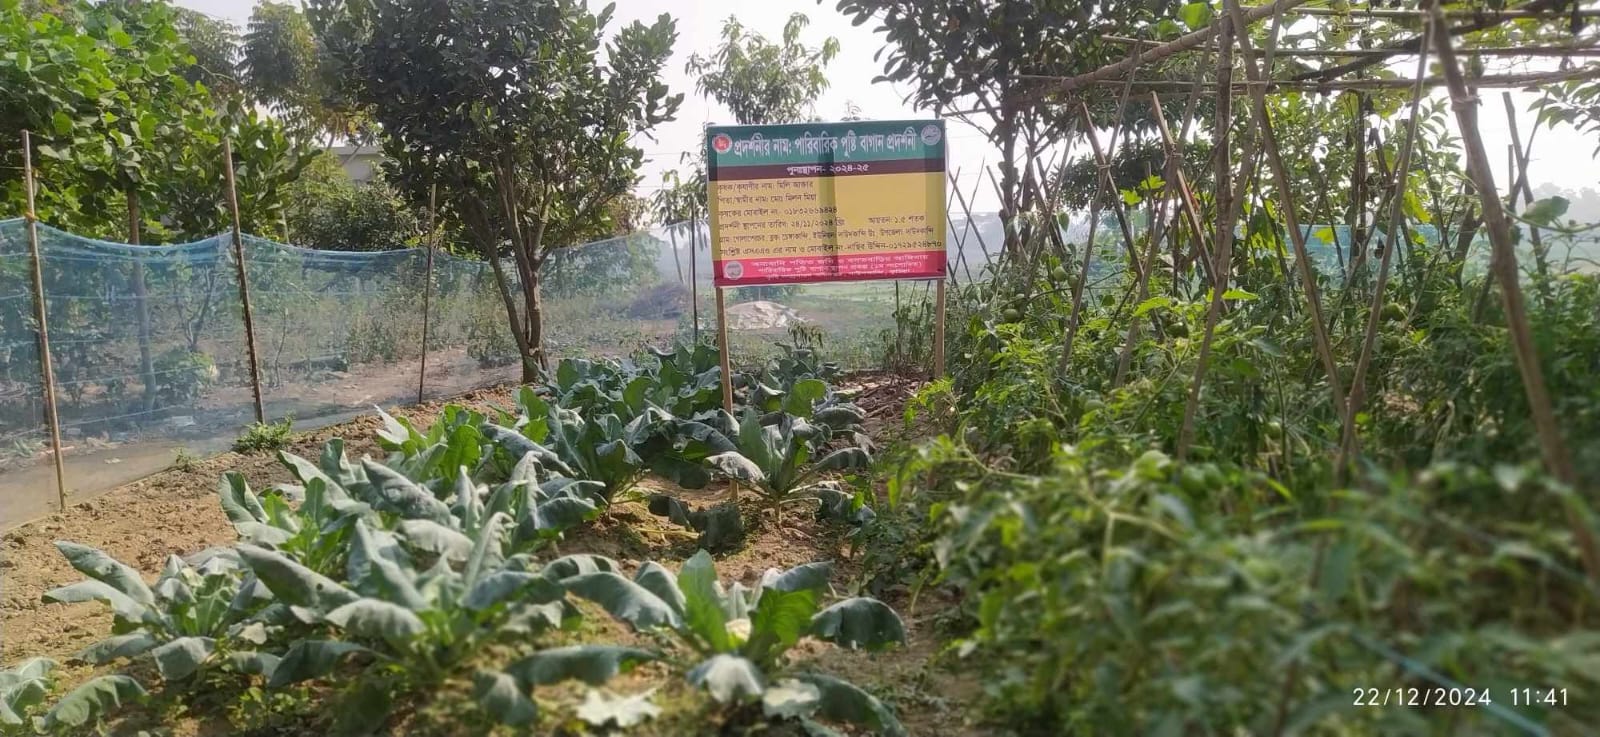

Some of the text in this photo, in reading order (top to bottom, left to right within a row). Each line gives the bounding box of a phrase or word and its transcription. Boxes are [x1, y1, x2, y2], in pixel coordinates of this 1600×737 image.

[734, 132, 770, 157] প্রদর্শনীর
[795, 130, 838, 156] পারিবারিক
[841, 129, 857, 158] পুষ্টি
[859, 133, 884, 153] বাগান
[887, 126, 917, 153] প্রদর্শনী
[830, 163, 869, 173] ২০২৪-২৫
[744, 207, 768, 216] মোবাইল
[807, 243, 834, 252] মোবাইল
